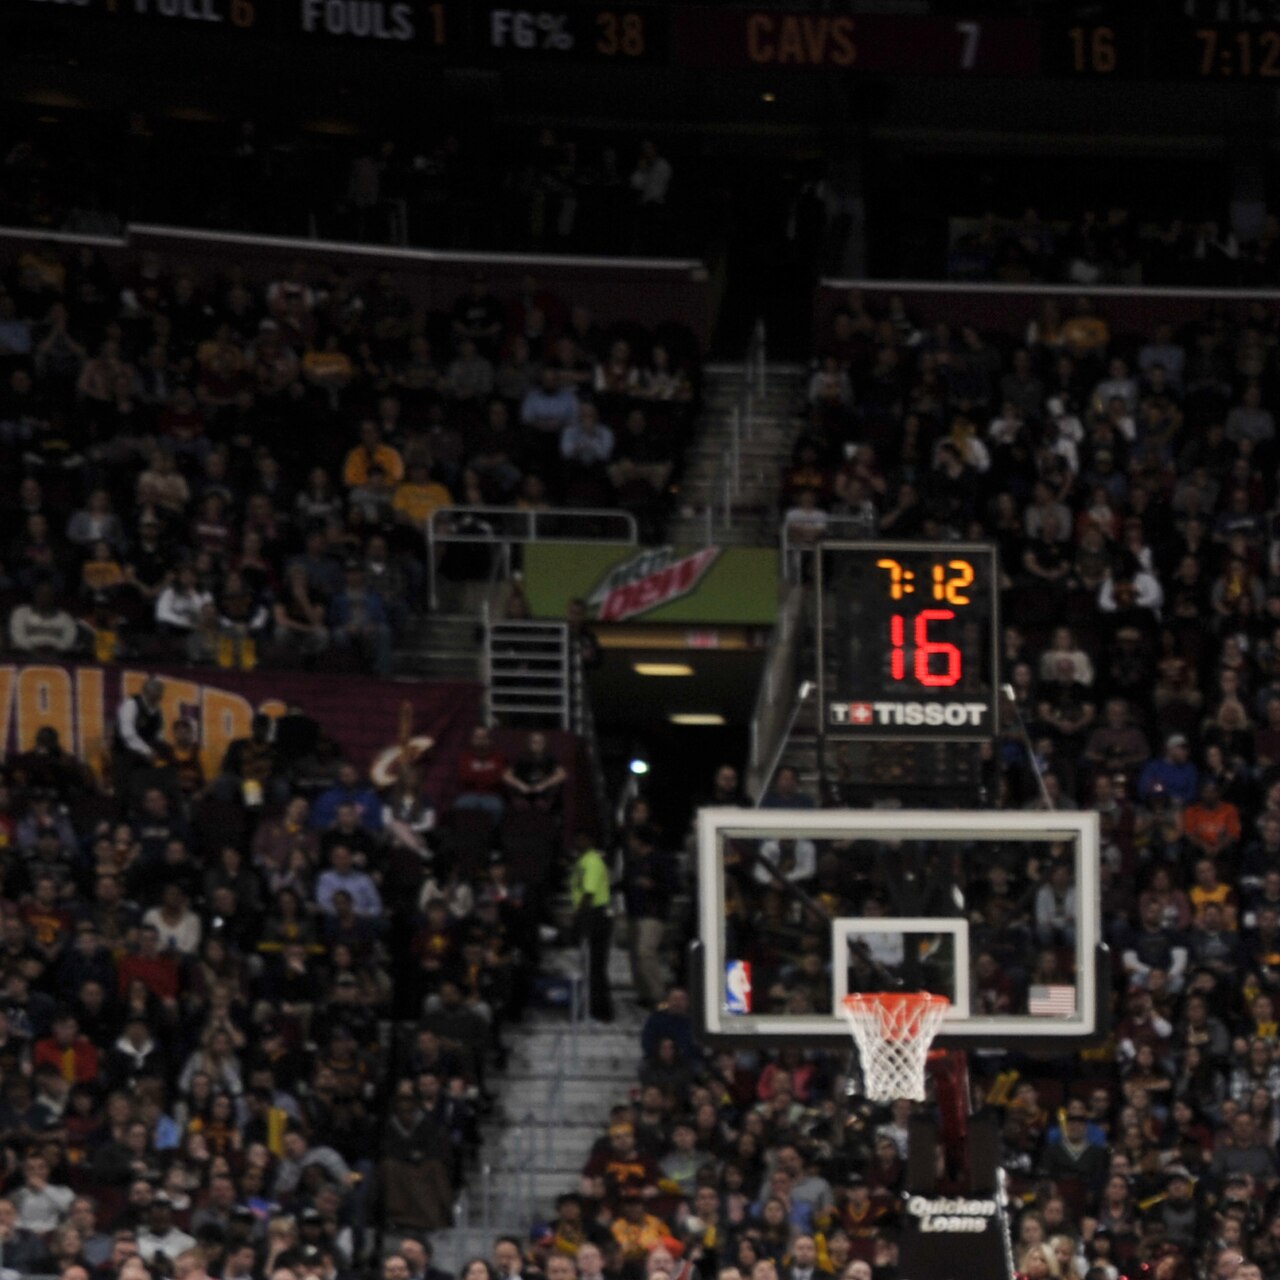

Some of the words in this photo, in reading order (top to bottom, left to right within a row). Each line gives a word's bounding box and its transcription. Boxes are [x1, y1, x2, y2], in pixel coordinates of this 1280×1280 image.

[300, 0, 417, 42] FOULS
[431, 2, 449, 46] 1
[490, 8, 575, 51] FG%
[595, 10, 648, 58] 38
[745, 14, 860, 67] CAVS
[954, 20, 981, 71] 7
[1068, 25, 1119, 77] 16
[876, 559, 975, 605] 7:12
[890, 609, 962, 687] 16
[873, 702, 987, 726] TISSOT
[907, 1195, 997, 1217] Quicken
[920, 1214, 988, 1233] Loans
